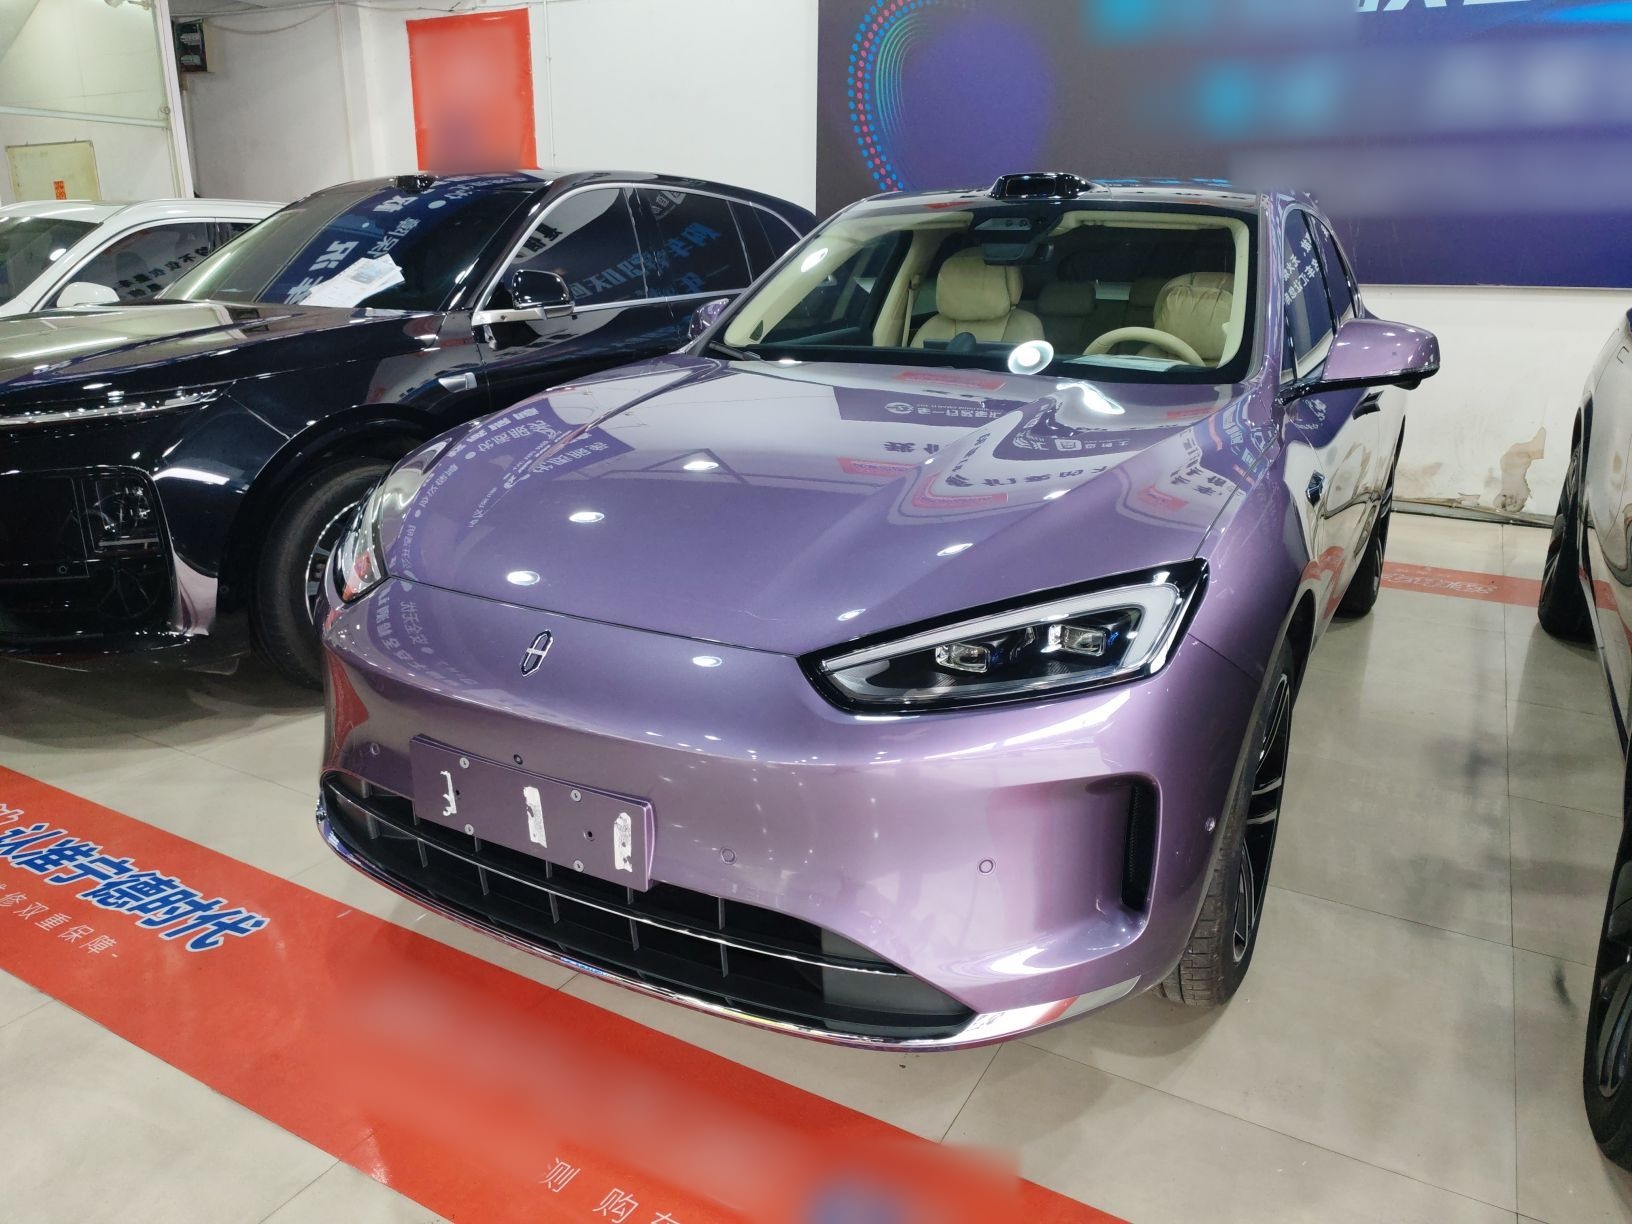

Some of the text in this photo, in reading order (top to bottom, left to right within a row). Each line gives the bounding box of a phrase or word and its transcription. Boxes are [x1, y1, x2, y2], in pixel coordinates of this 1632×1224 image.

[0, 822, 271, 952] 认准宁德时代
